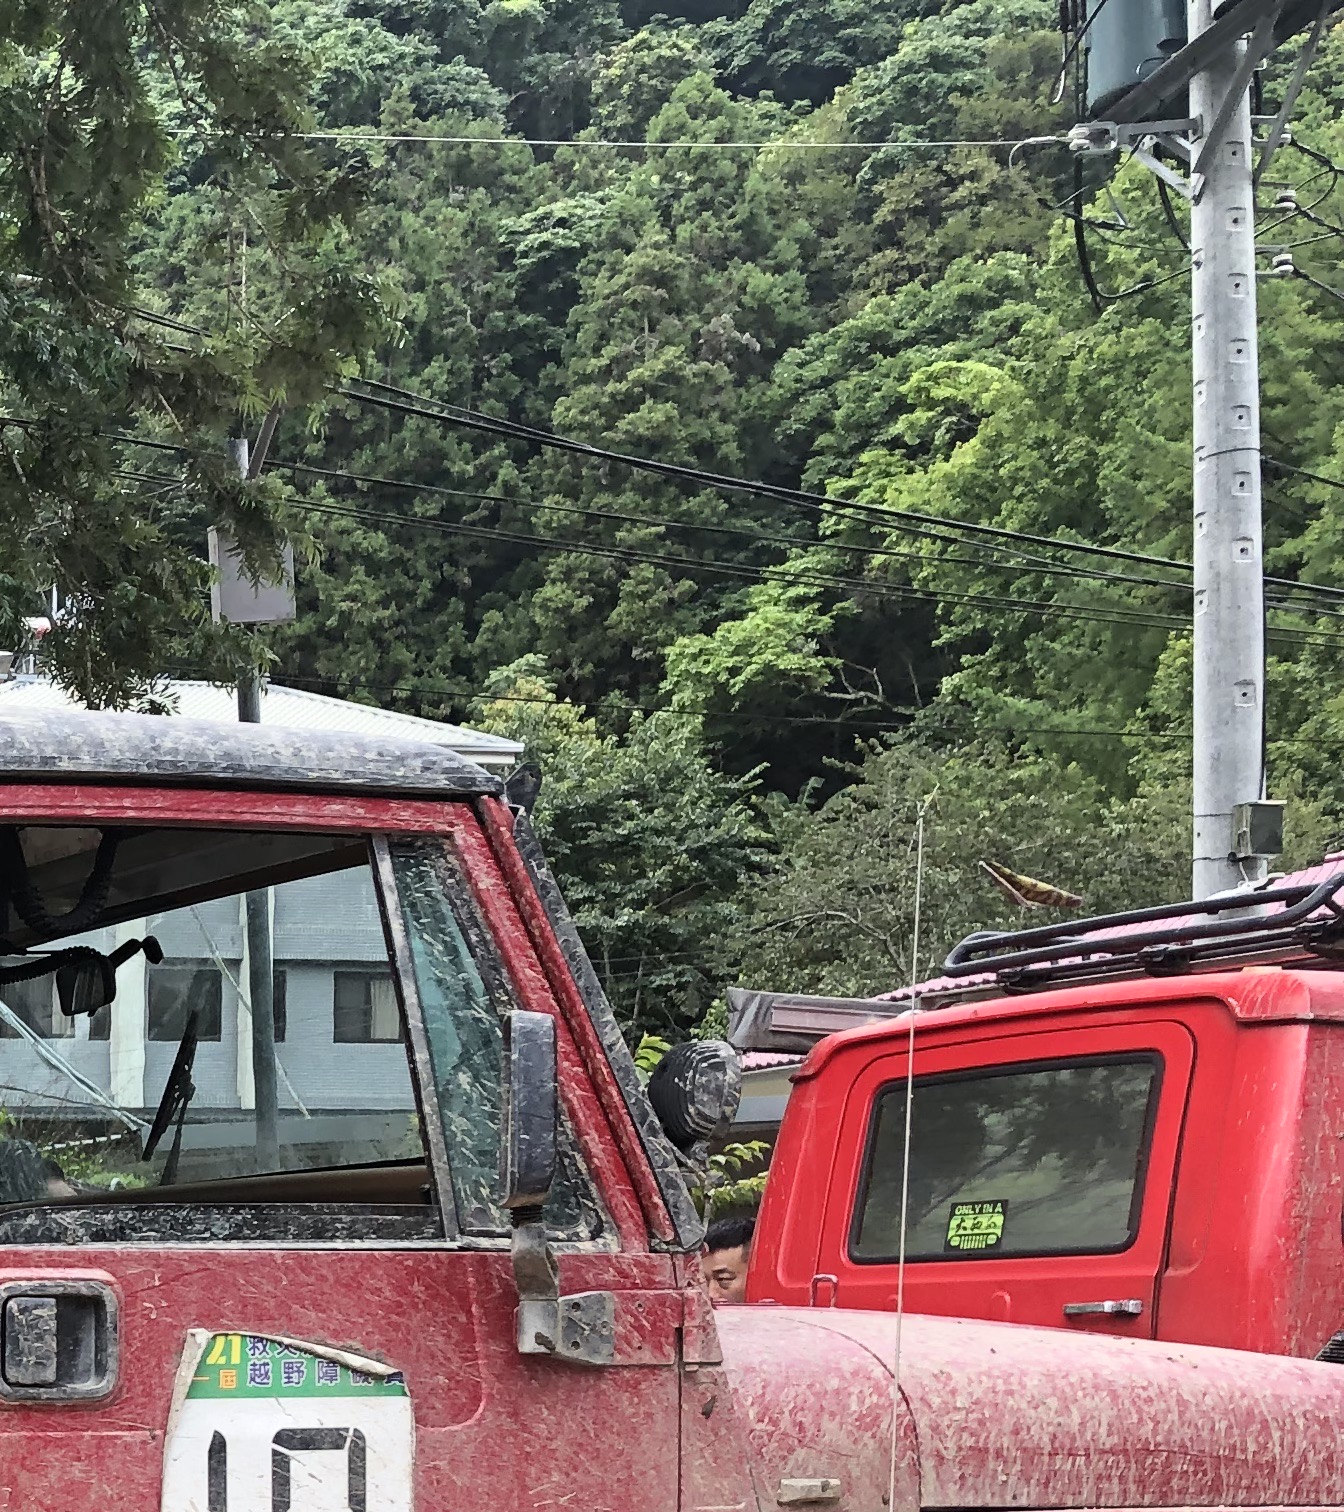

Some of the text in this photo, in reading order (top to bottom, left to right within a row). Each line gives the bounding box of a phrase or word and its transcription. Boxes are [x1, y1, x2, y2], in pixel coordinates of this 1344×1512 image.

[955, 1203, 1002, 1215] ONLY IN A
